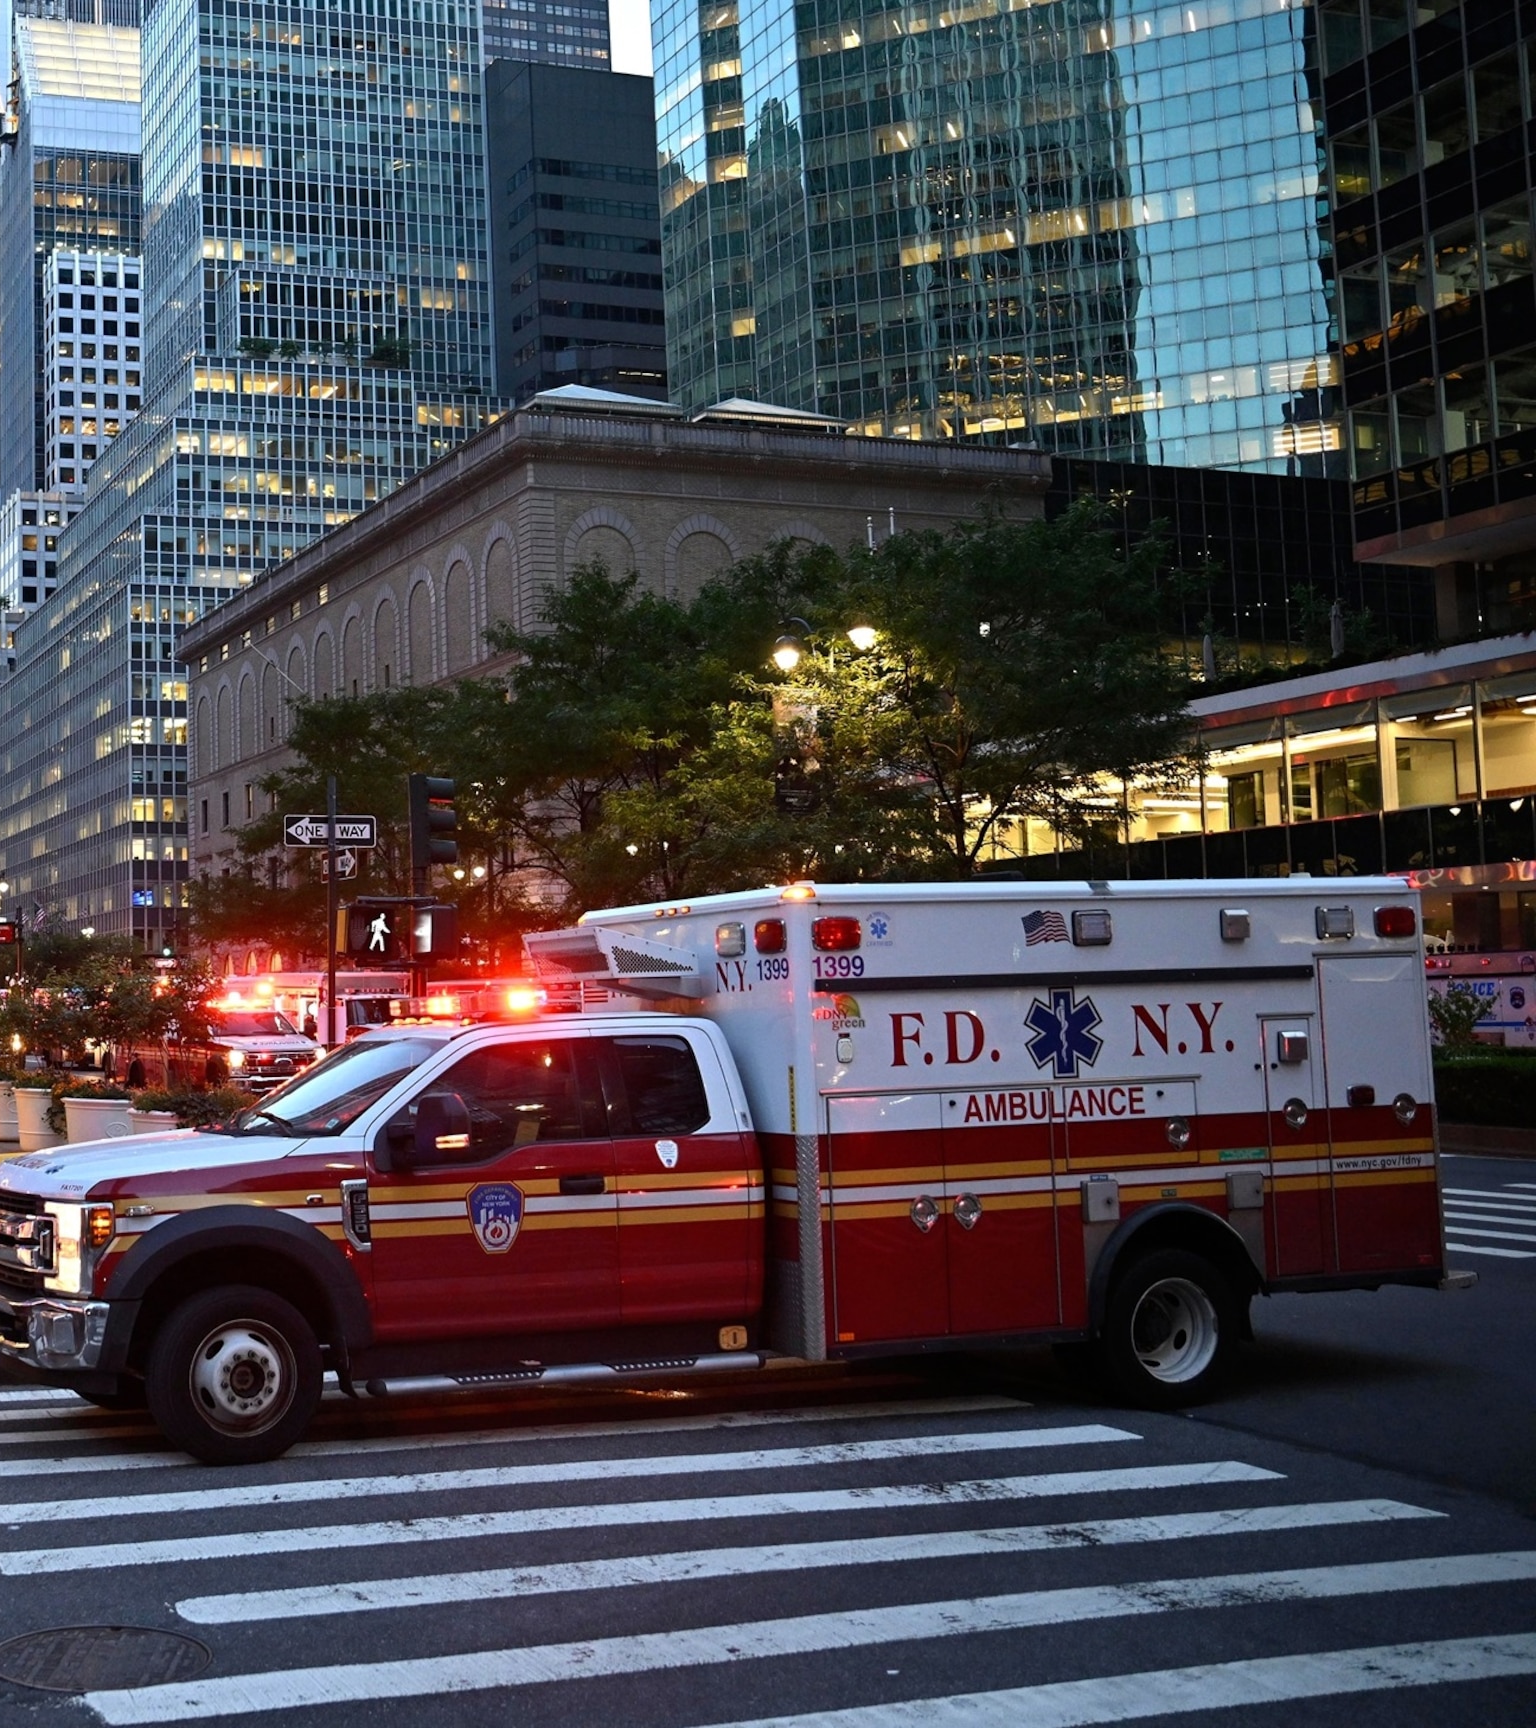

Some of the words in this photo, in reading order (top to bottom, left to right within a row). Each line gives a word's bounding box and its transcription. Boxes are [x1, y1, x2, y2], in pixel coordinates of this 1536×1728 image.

[295, 825, 324, 837] ONE
[339, 826, 367, 837] WAY
[812, 956, 865, 977] 1399
[716, 960, 752, 993] N.Y.
[756, 958, 789, 981] 1399
[1448, 982, 1495, 996] OICE
[816, 1009, 849, 1020] FDNY
[832, 1018, 866, 1031] green
[889, 1010, 1000, 1067] F.D.
[1131, 1002, 1235, 1057] N.Y.
[964, 1087, 1146, 1123] AMBULANCE
[1336, 1155, 1422, 1169] www.nyc.gov/fdny
